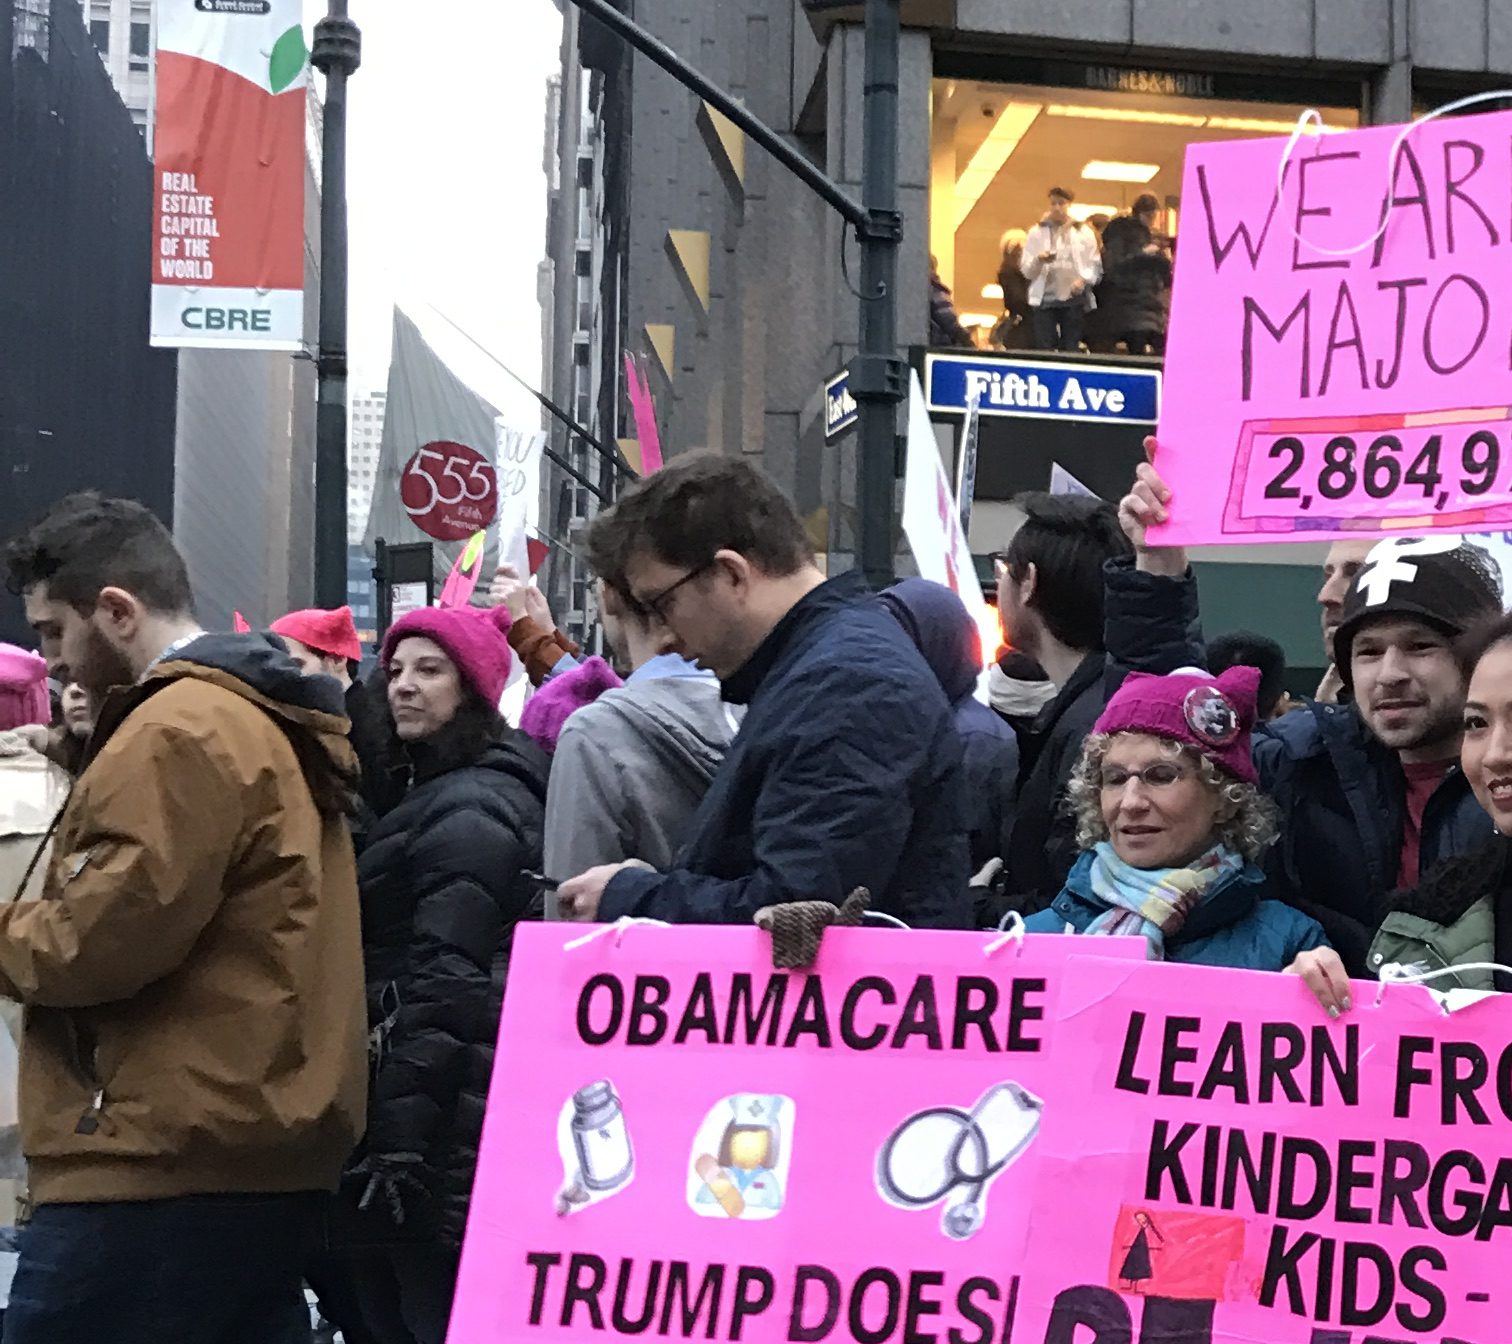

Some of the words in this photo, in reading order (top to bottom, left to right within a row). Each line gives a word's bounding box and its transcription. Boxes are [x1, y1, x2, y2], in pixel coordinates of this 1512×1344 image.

[161, 171, 198, 193] REAL
[161, 194, 214, 215] ESTATE
[1196, 151, 1361, 273] WE
[160, 216, 220, 237] CAPITAL
[160, 238, 179, 256] OF
[183, 239, 210, 258] THE
[160, 259, 213, 280] WORLD
[181, 307, 271, 332] CBRE
[964, 369, 1050, 407] Fifth
[1058, 377, 1125, 412] Ave
[405, 448, 491, 516] 555
[575, 971, 1047, 1053] OBAMACARE
[1114, 1011, 1360, 1107] LEARN
[526, 1251, 776, 1342] TRUMP
